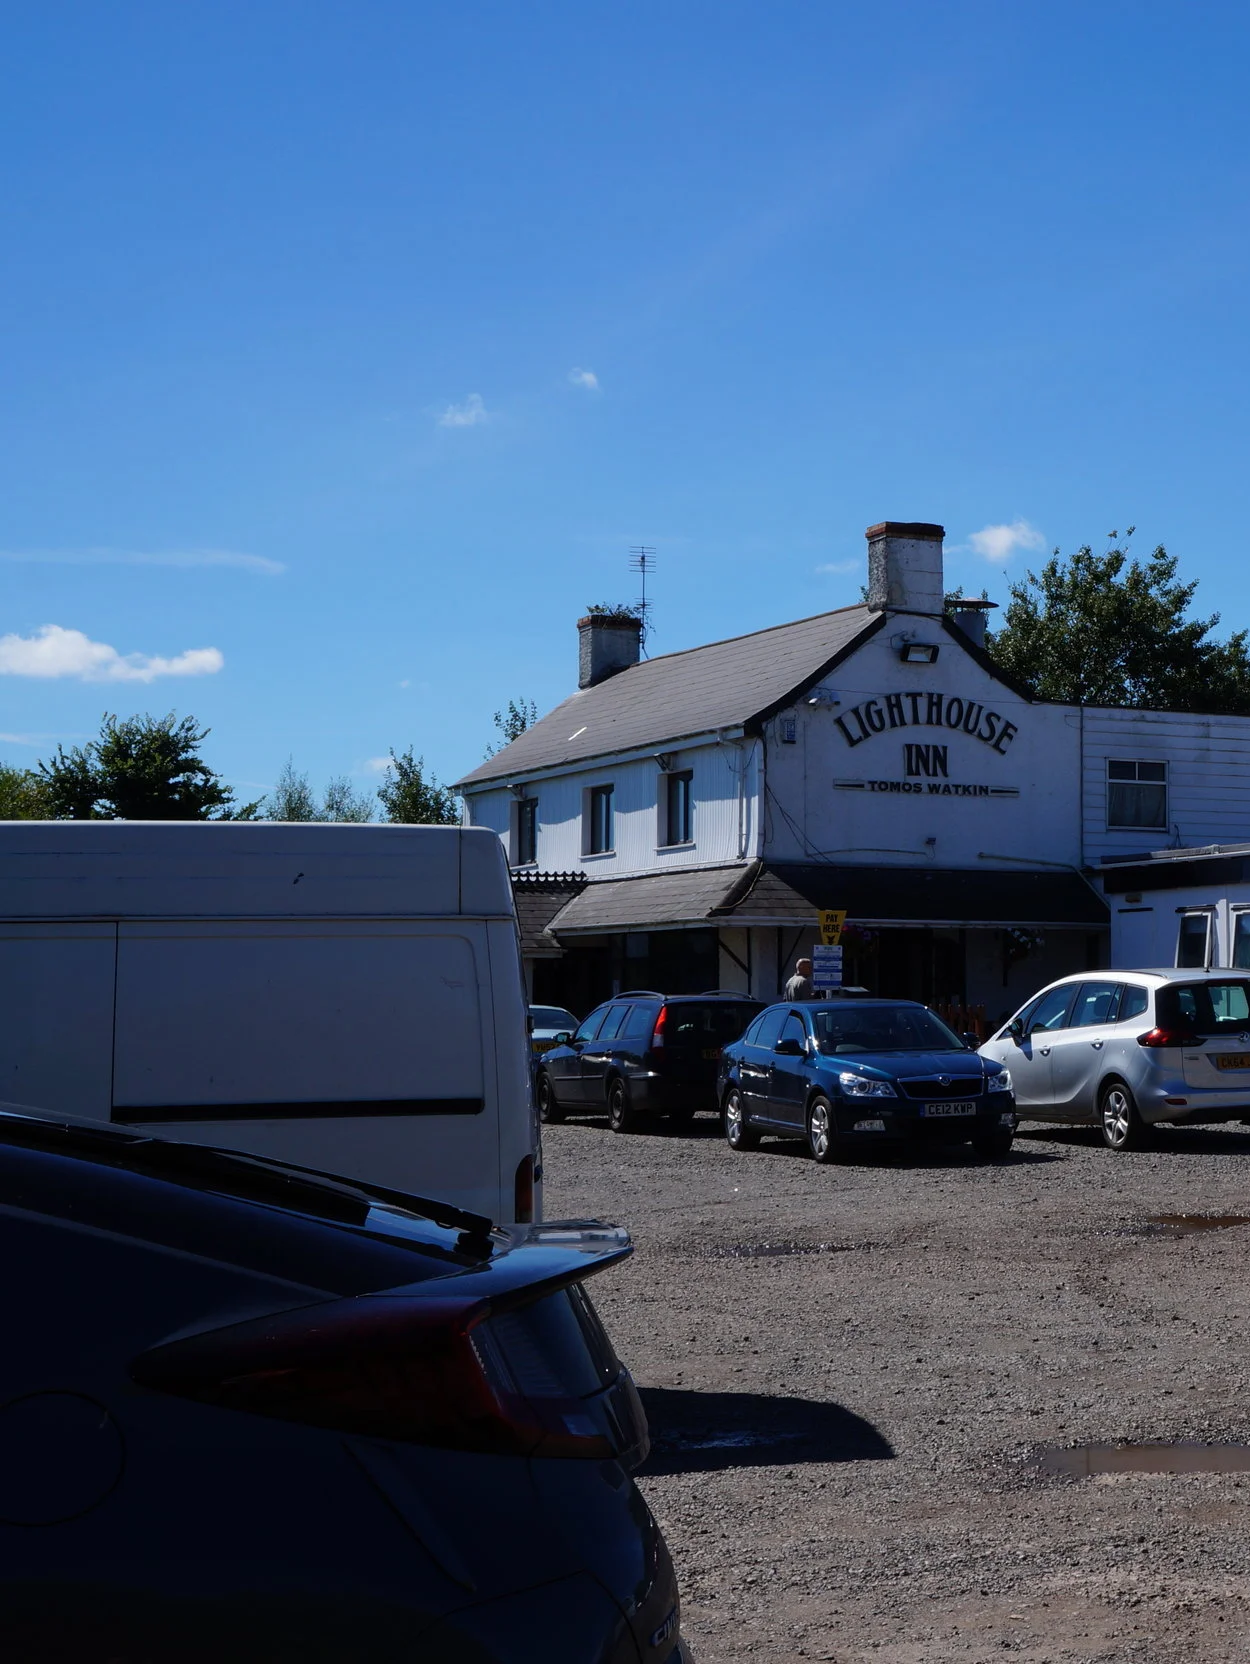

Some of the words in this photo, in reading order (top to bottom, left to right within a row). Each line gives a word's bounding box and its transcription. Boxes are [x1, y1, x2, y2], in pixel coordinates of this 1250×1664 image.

[833, 691, 1018, 756] LIGHTHOUSE
[903, 743, 949, 778] INN
[867, 780, 923, 794] TOMOS
[928, 783, 989, 796] WATKIN
[825, 913, 839, 923] PAY
[823, 924, 840, 933] HERE
[928, 1104, 952, 1115] CE12
